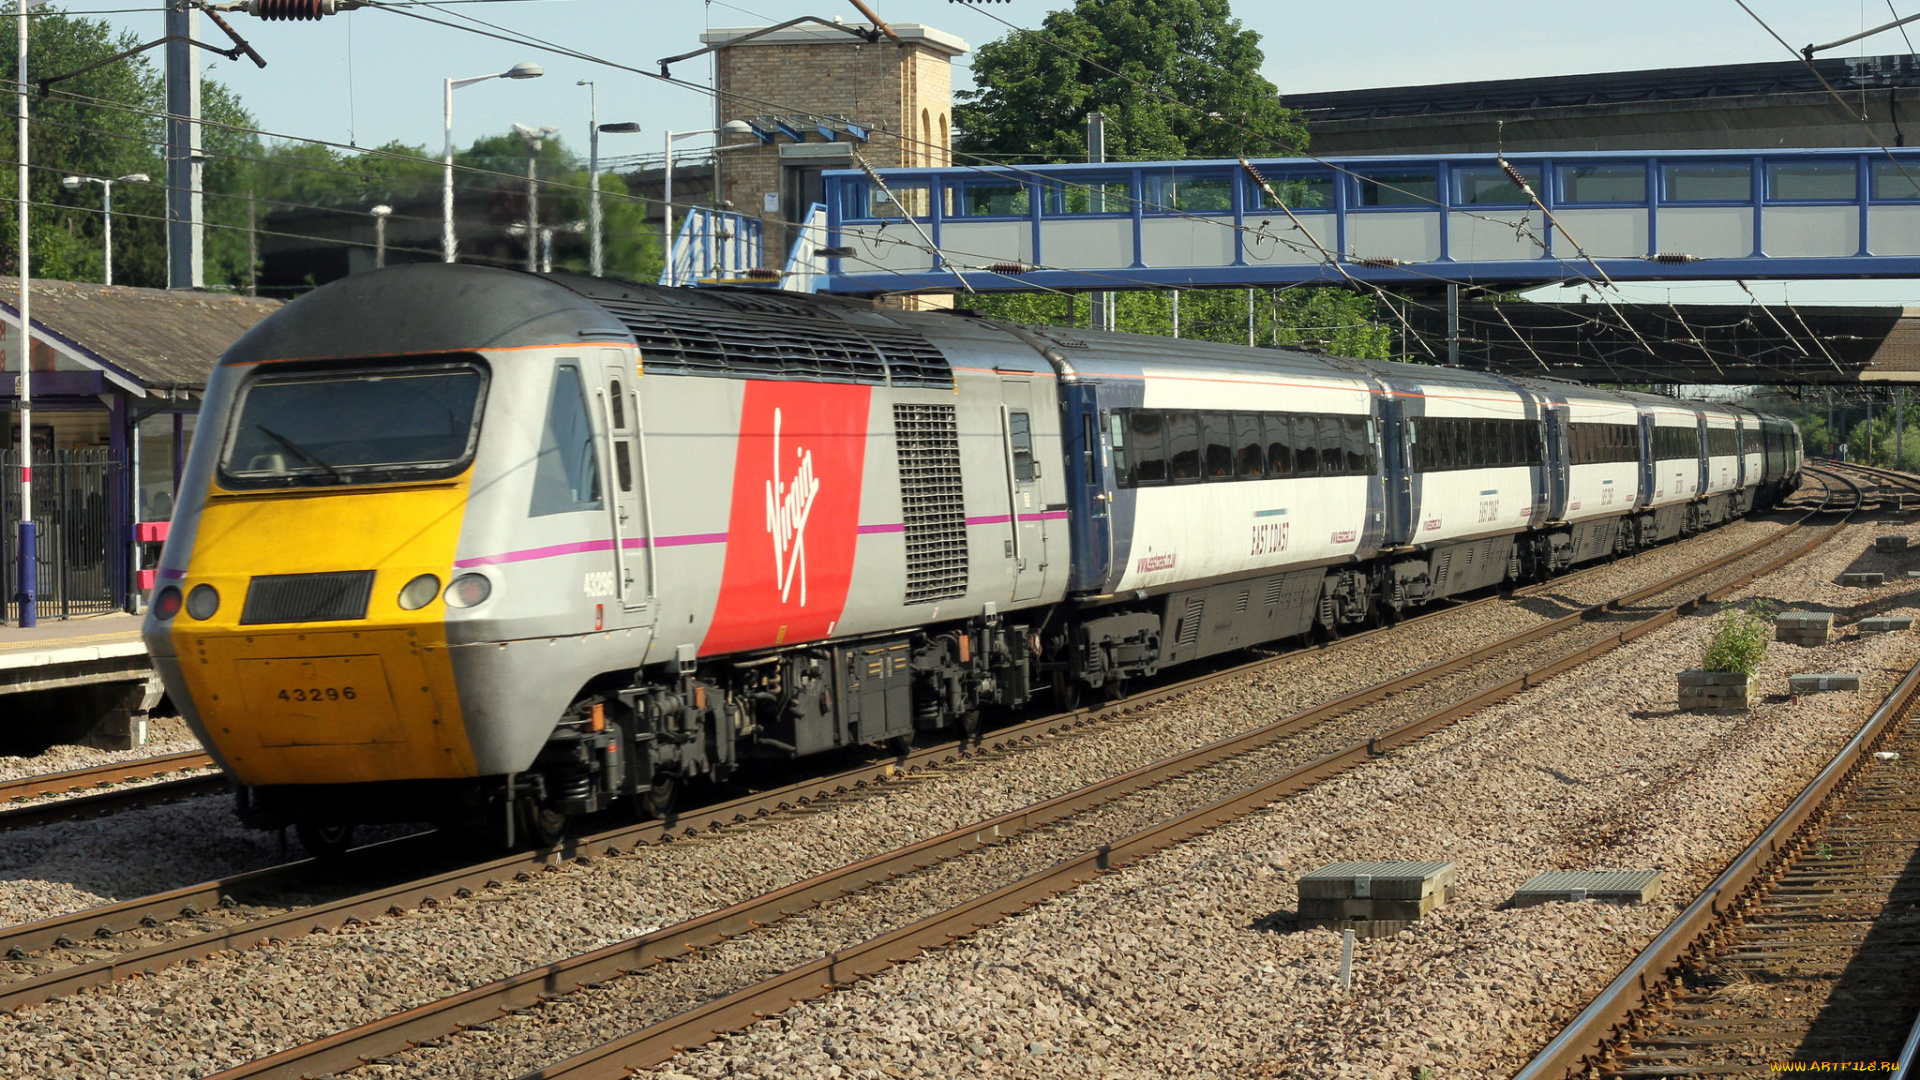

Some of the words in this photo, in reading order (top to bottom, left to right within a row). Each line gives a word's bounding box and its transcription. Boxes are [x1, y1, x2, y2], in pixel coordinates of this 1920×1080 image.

[766, 407, 819, 607] Virgin
[1251, 525, 1269, 556] EAST
[1269, 521, 1289, 553] COAST
[278, 686, 357, 702] 43296
